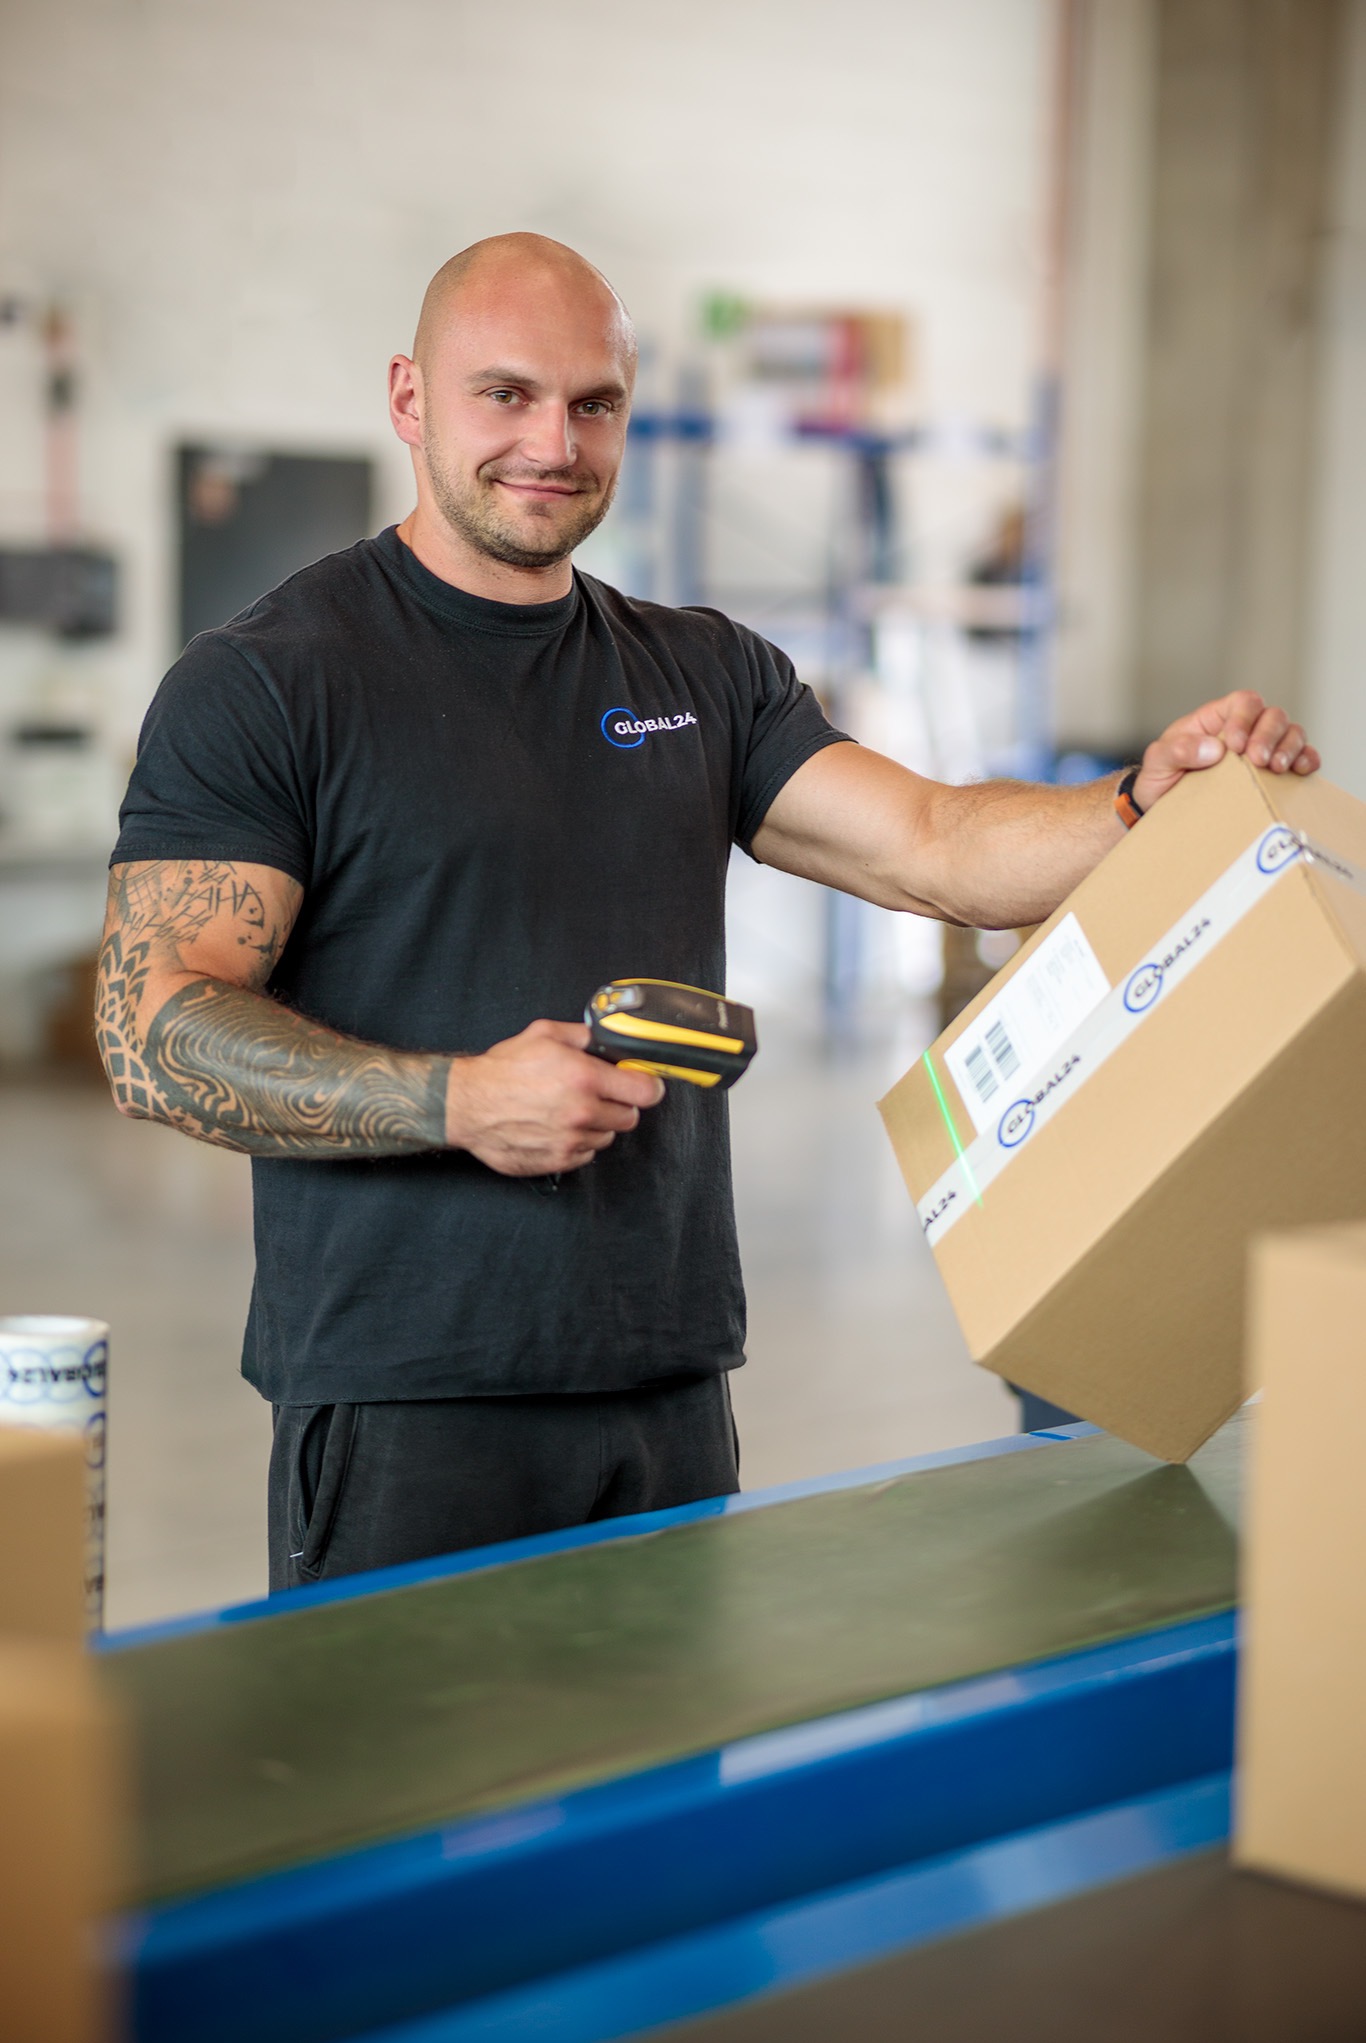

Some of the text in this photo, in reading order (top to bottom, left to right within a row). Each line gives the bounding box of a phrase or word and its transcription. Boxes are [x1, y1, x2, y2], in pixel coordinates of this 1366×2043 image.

[614, 711, 697, 735] GLOBAL24
[1134, 918, 1211, 998] GLOBAL24
[1007, 1054, 1081, 1134] GLOBAL24
